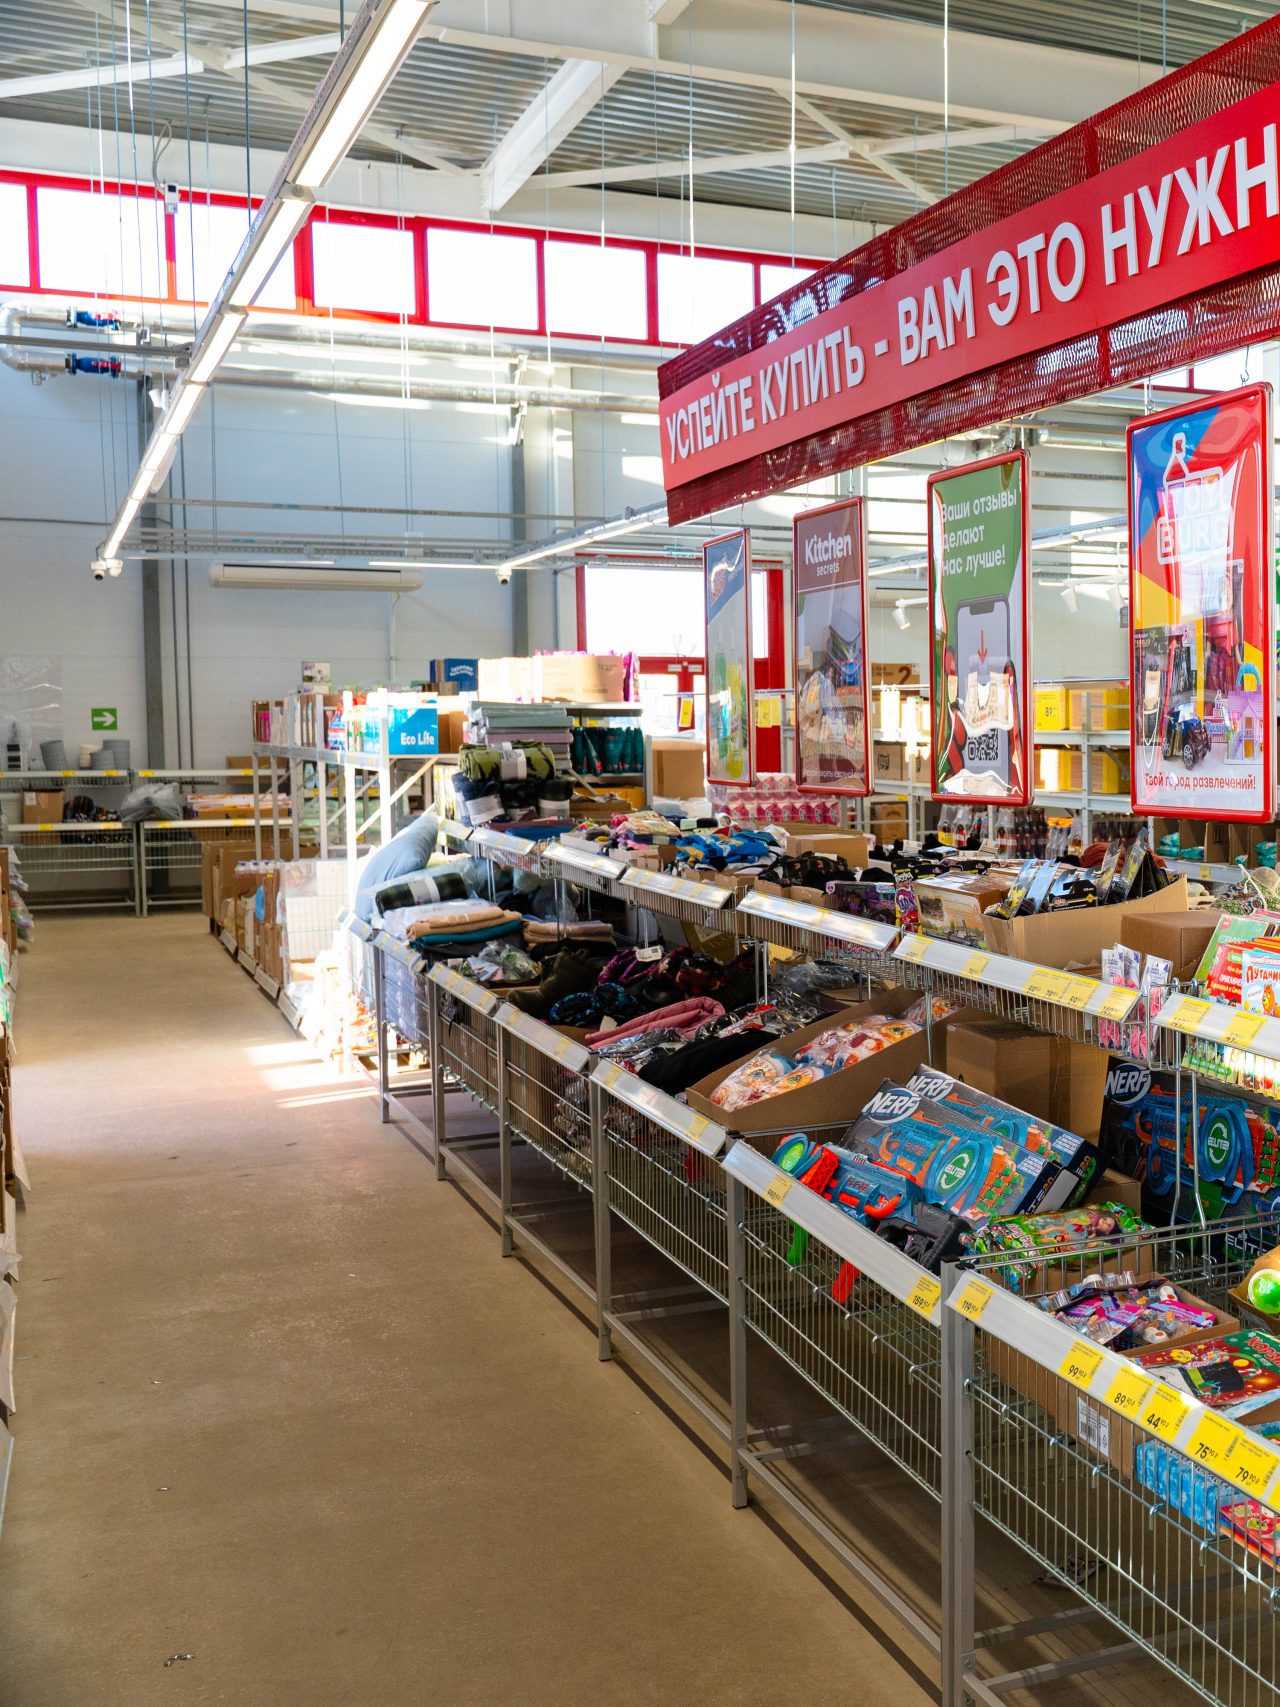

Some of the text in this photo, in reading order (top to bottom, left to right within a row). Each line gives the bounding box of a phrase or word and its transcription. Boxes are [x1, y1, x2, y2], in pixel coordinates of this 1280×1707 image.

[665, 371, 756, 464] УСПЕЙТЕ
[759, 326, 866, 425] КУПИТЬ
[897, 268, 976, 366] ВАМ
[986, 221, 1086, 327] ЭТО
[942, 489, 1017, 523] Ваши отзывы
[943, 524, 985, 552] делают
[804, 533, 852, 565] Kitchen
[942, 543, 1006, 577] нас лучше!
[816, 562, 840, 577] secrets
[400, 730, 435, 746] Eco Life
[1192, 774, 1257, 791] развлечений!
[904, 1075, 953, 1097] NERF
[1104, 1068, 1151, 1096] NERF
[861, 1090, 921, 1117] NERF
[912, 1294, 924, 1308] 159
[962, 1299, 972, 1312] 119
[1068, 1364, 1079, 1377] 99
[1113, 1392, 1126, 1406] 89
[1146, 1412, 1161, 1429] 44
[1194, 1442, 1209, 1459] 75
[1235, 1466, 1250, 1483] 79
